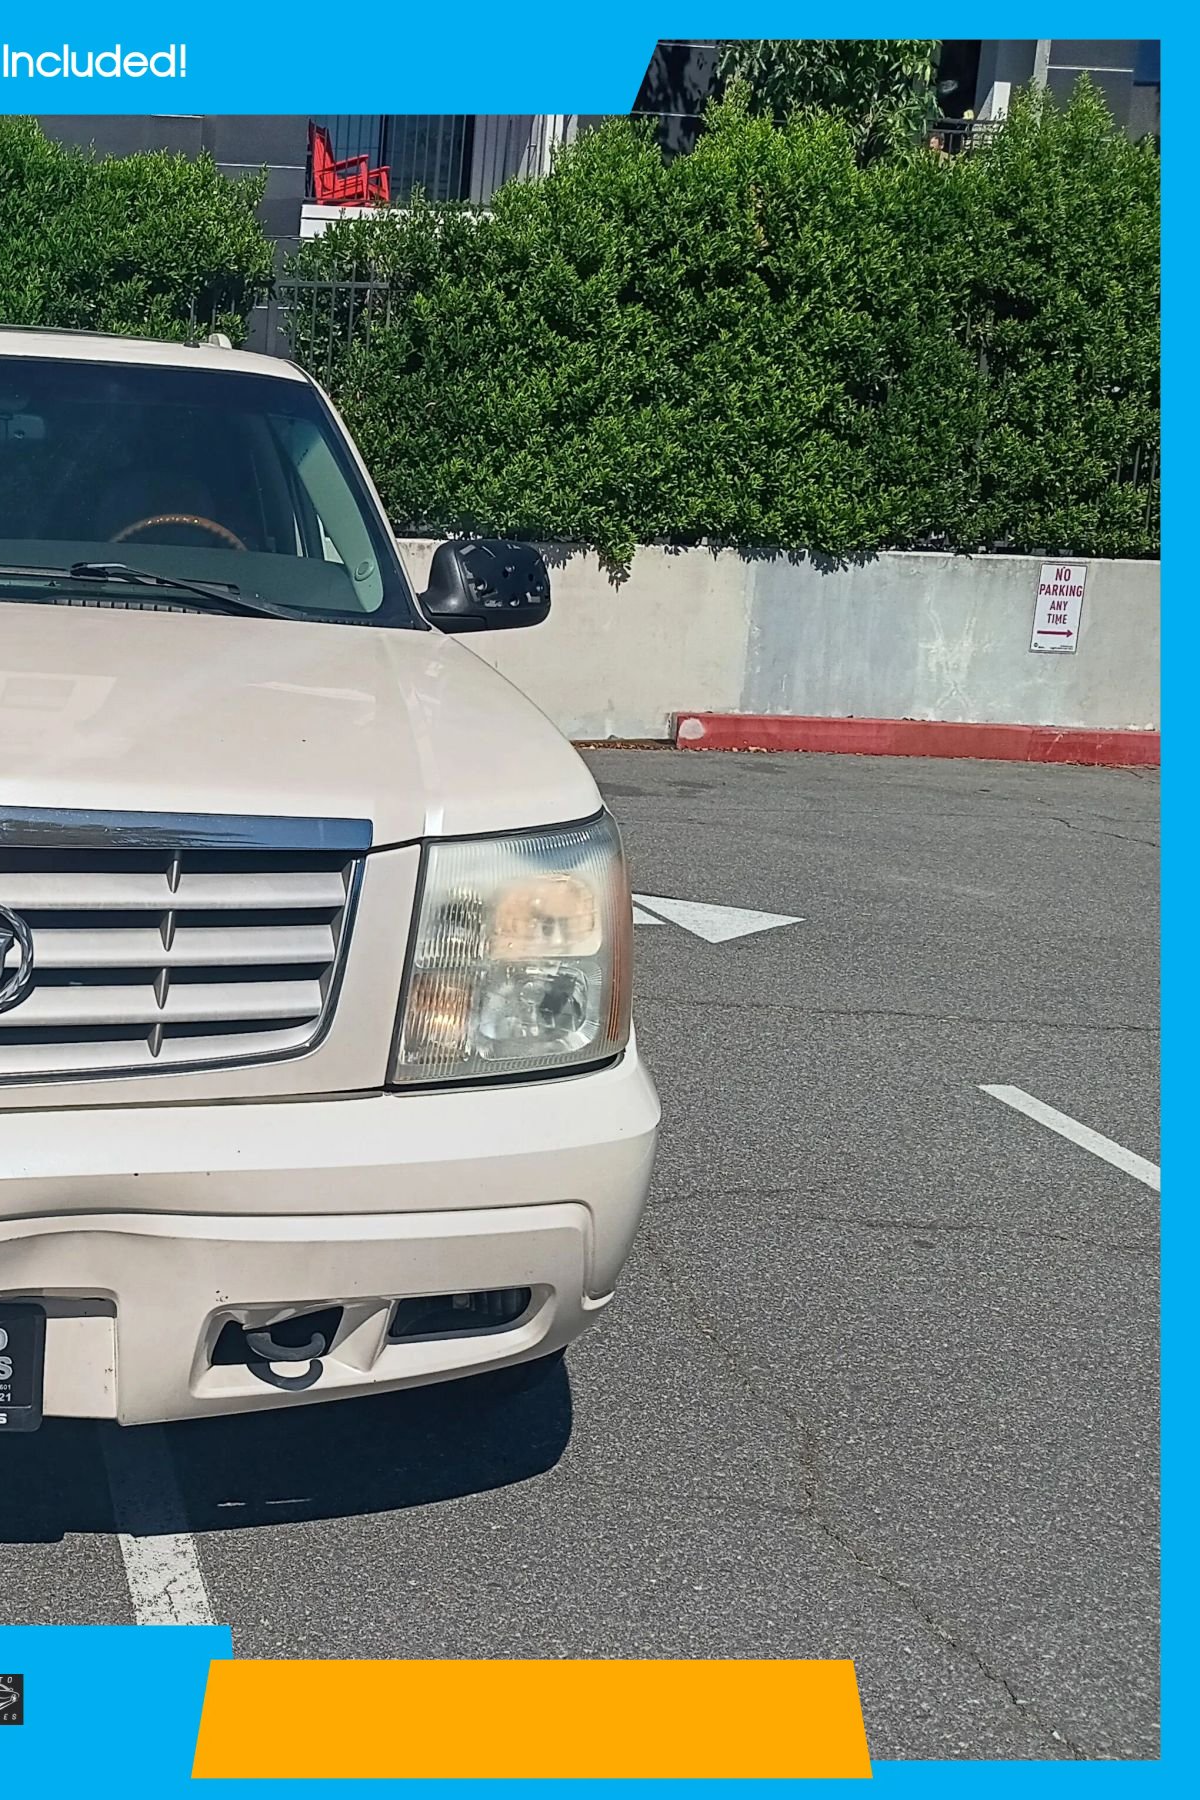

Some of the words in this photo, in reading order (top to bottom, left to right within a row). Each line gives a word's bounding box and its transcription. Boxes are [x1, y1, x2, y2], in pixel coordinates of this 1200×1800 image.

[1055, 568, 1071, 581] NO
[1039, 584, 1083, 597] PARKING
[1049, 600, 1068, 611] ANY
[1047, 613, 1068, 624] TIME
